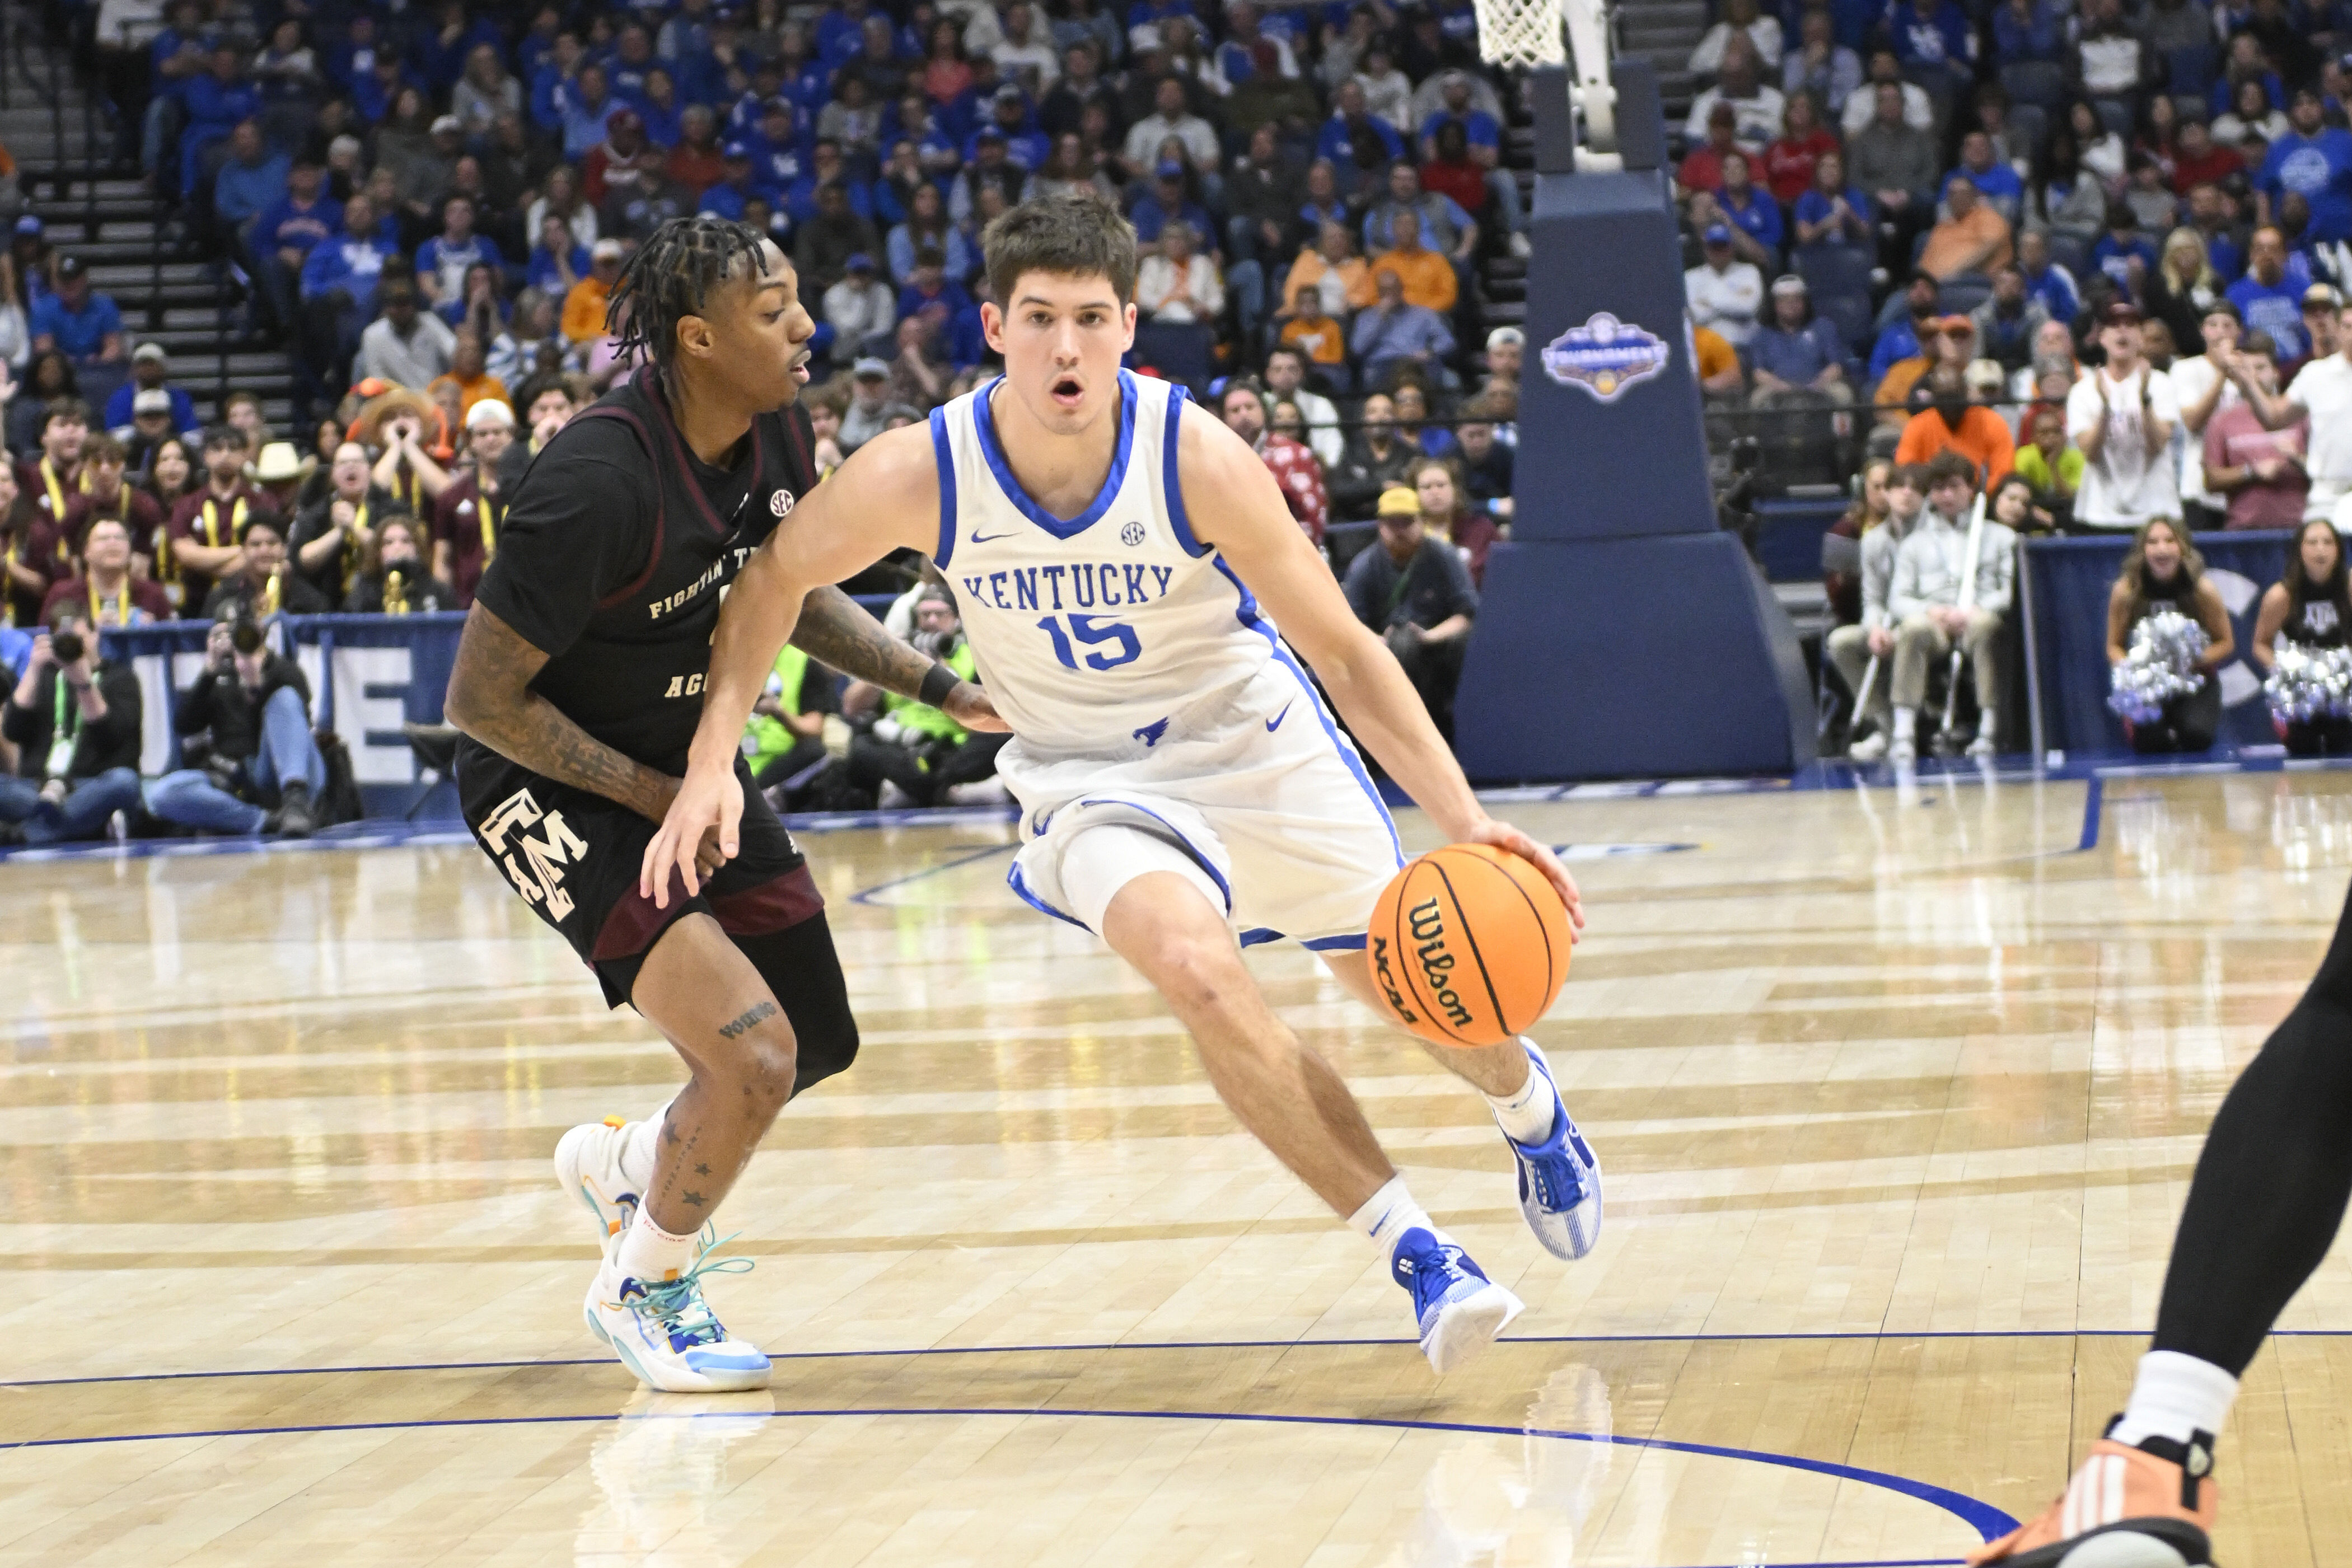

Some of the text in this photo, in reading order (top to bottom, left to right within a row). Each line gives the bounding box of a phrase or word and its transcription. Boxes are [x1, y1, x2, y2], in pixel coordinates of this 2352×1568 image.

[770, 490, 794, 516] SEC
[1121, 522, 1145, 545] SEC
[963, 563, 1173, 611] KENTUCKY
[1036, 612, 1143, 671] 15
[665, 673, 708, 698] AG
[1374, 936, 1419, 1024] NCAA
[1408, 895, 1474, 1028] Wilson
